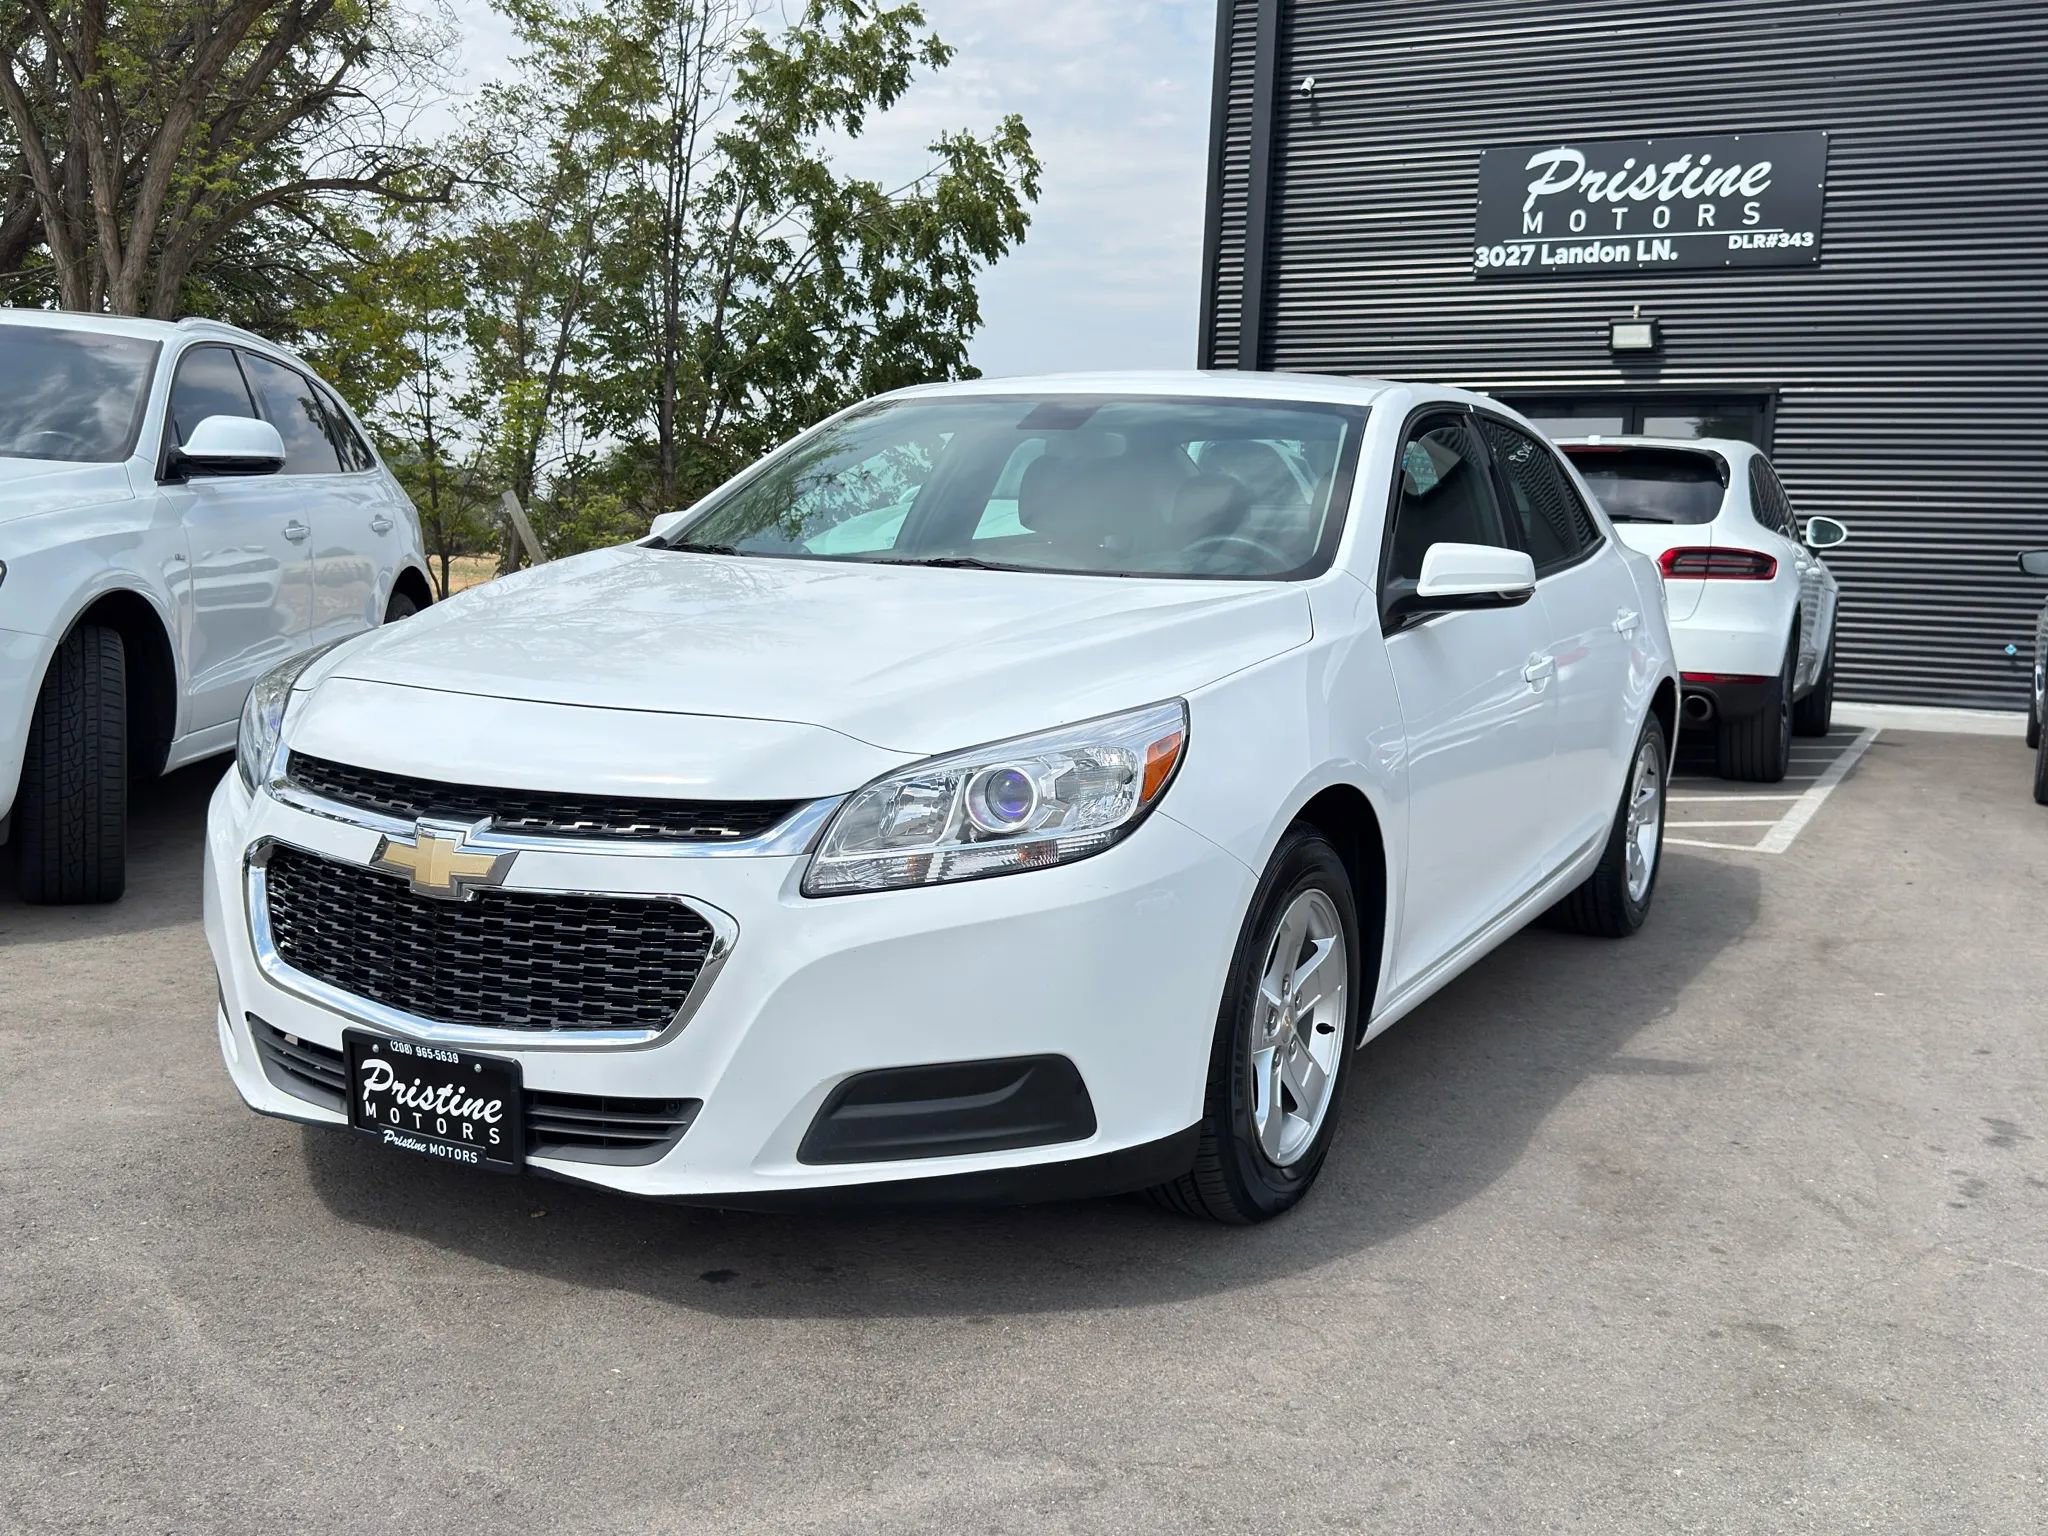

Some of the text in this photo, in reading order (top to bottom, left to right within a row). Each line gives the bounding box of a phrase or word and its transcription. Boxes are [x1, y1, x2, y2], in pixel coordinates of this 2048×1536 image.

[1523, 149, 1772, 212] Pristine
[1523, 202, 1760, 234] MOTORS
[1474, 239, 1679, 268] 3027 Landon LN.
[1728, 232, 1814, 249] DLR#343
[390, 1040, 459, 1064] (208) 965-5639
[361, 1058, 503, 1123] Pristine
[365, 1100, 500, 1144] MOTORS
[383, 1129, 478, 1164] Pristine MOTORS
